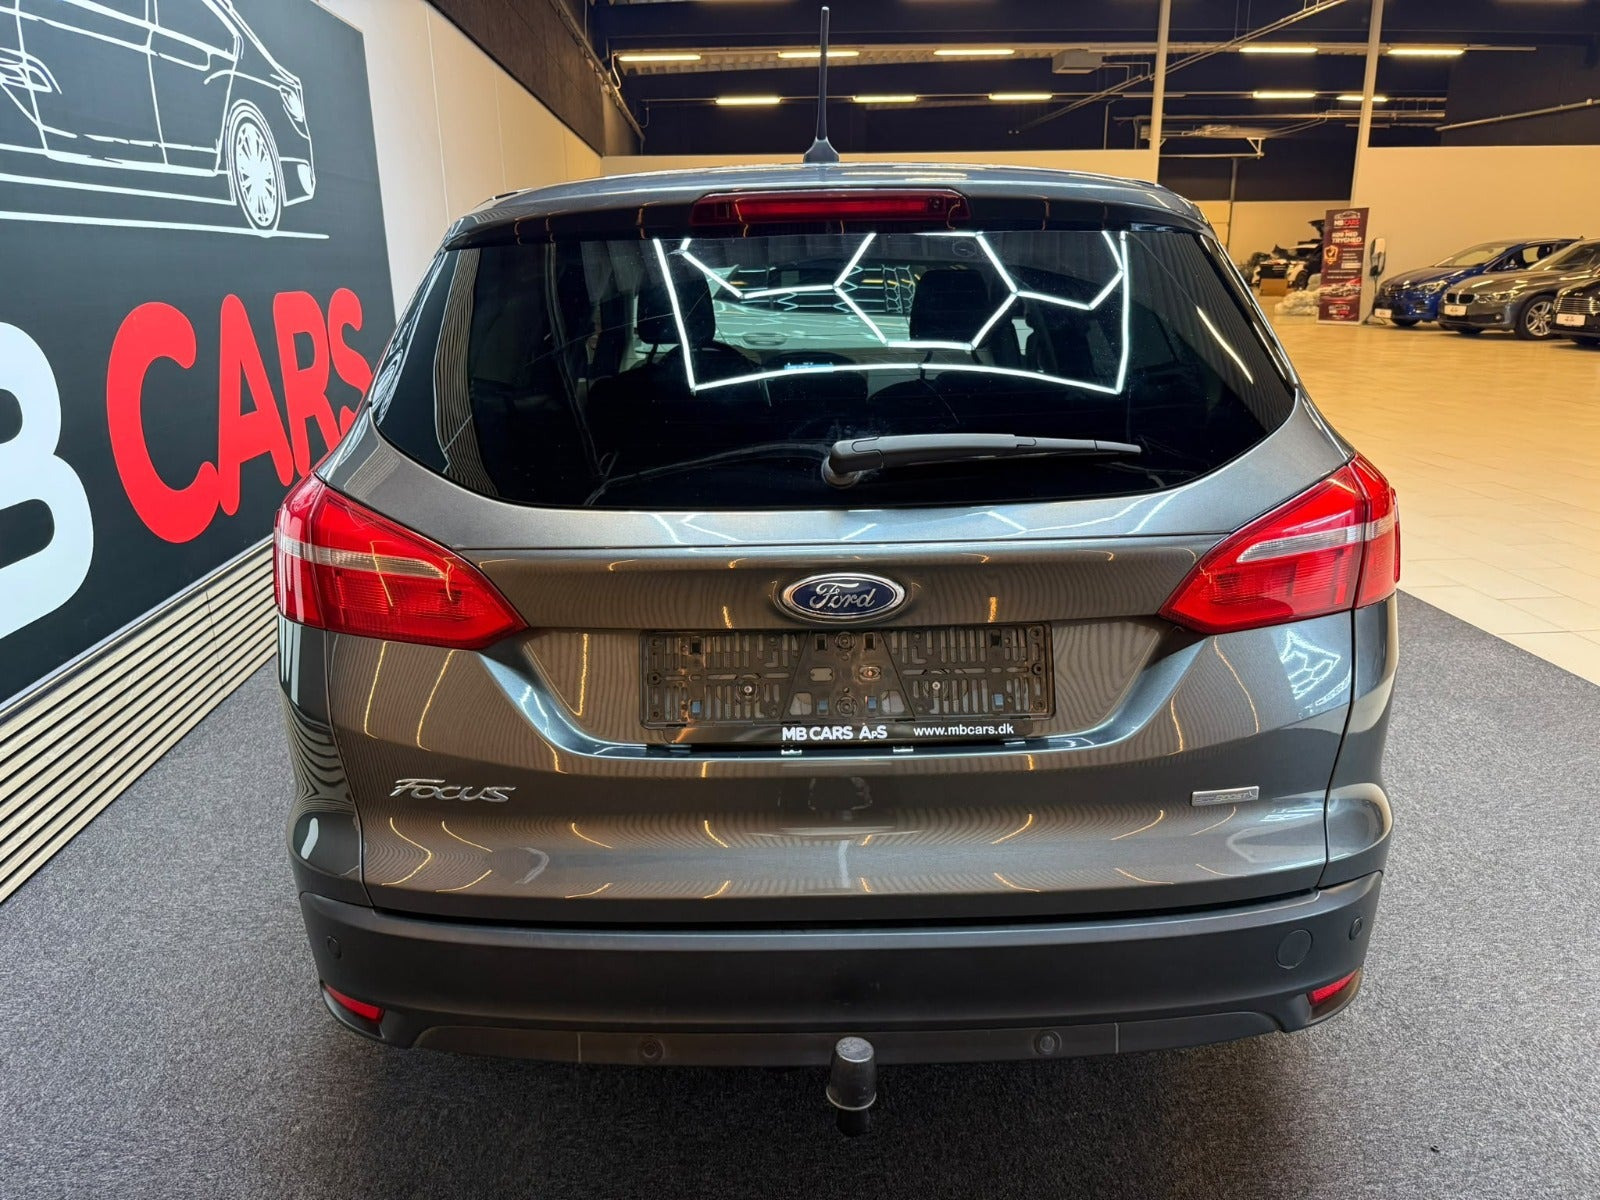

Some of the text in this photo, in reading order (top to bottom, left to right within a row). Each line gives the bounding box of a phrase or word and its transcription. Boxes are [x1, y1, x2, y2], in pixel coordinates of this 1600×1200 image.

[106, 287, 374, 543] CARS
[809, 582, 876, 609] Ford
[782, 726, 808, 741] MB
[809, 725, 853, 740] CARS
[913, 722, 1014, 736] www.mbcars.dk
